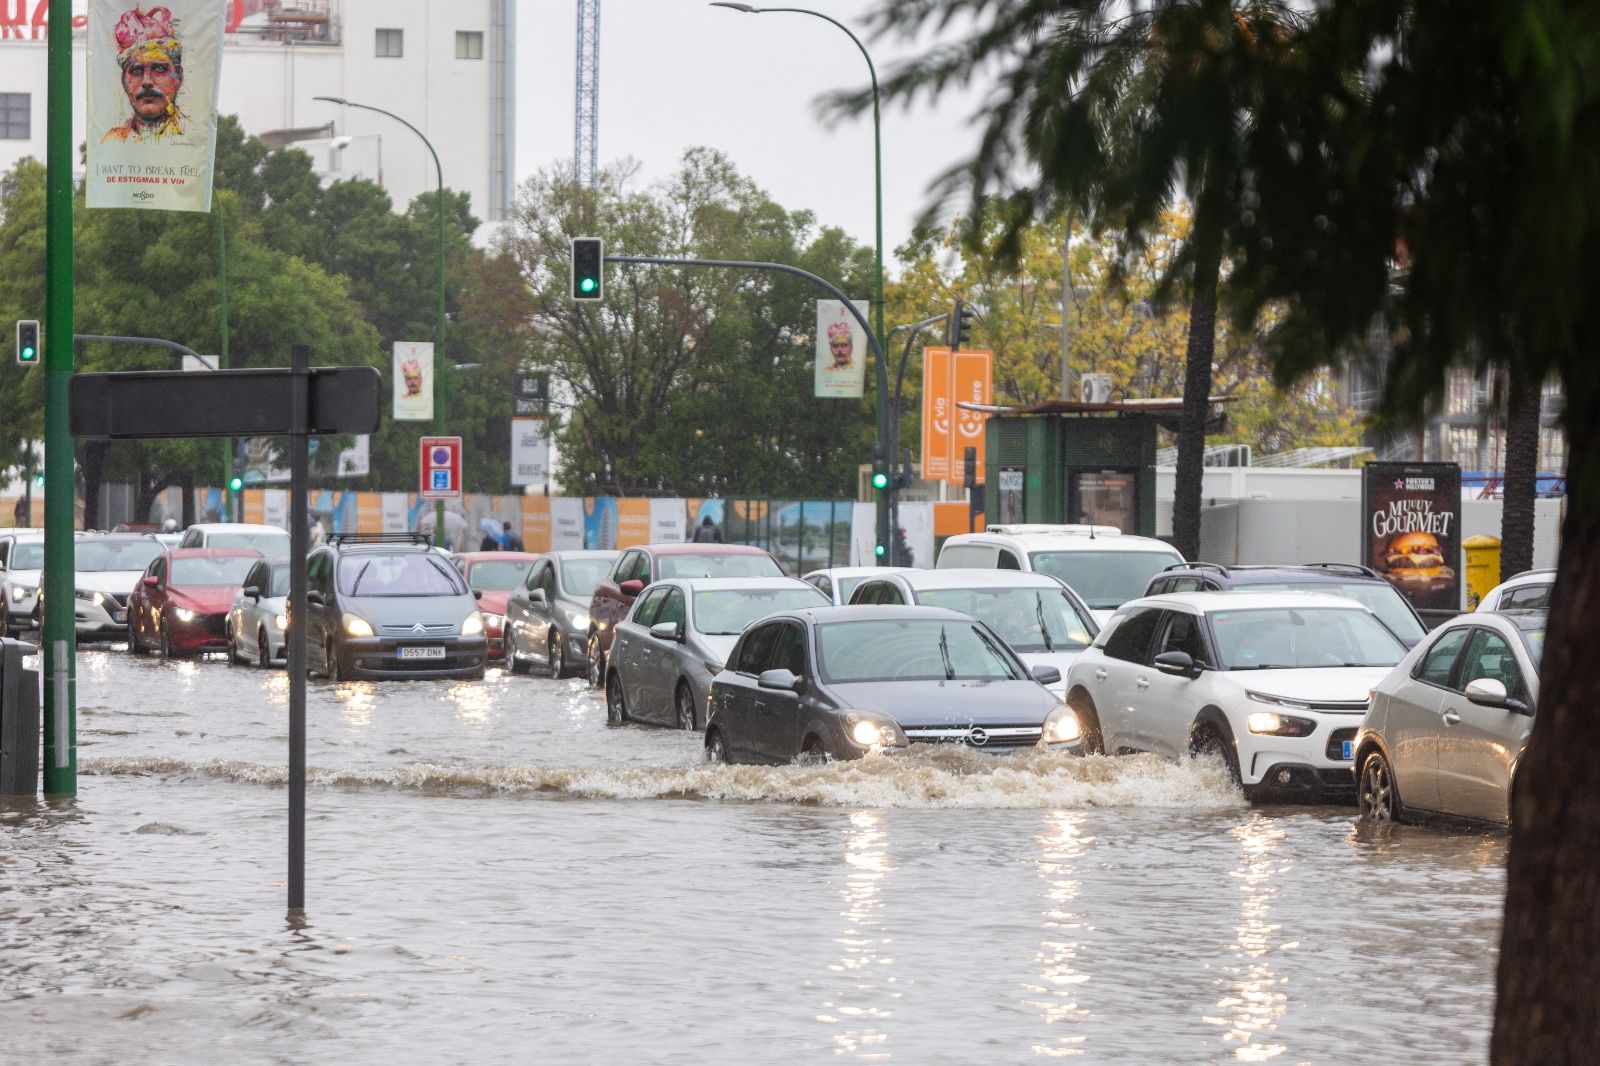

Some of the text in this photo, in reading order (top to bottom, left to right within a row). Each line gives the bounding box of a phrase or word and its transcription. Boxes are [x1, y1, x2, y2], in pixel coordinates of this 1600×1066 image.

[95, 164, 99, 176] I
[101, 164, 125, 174] WANT
[127, 165, 141, 174] TO
[145, 165, 176, 176] BREAK
[118, 176, 160, 184] ESTIGMAS
[1389, 499, 1433, 516] MUUUY
[1373, 509, 1454, 538] GOURMET
[403, 648, 443, 657] 0557 DNK
